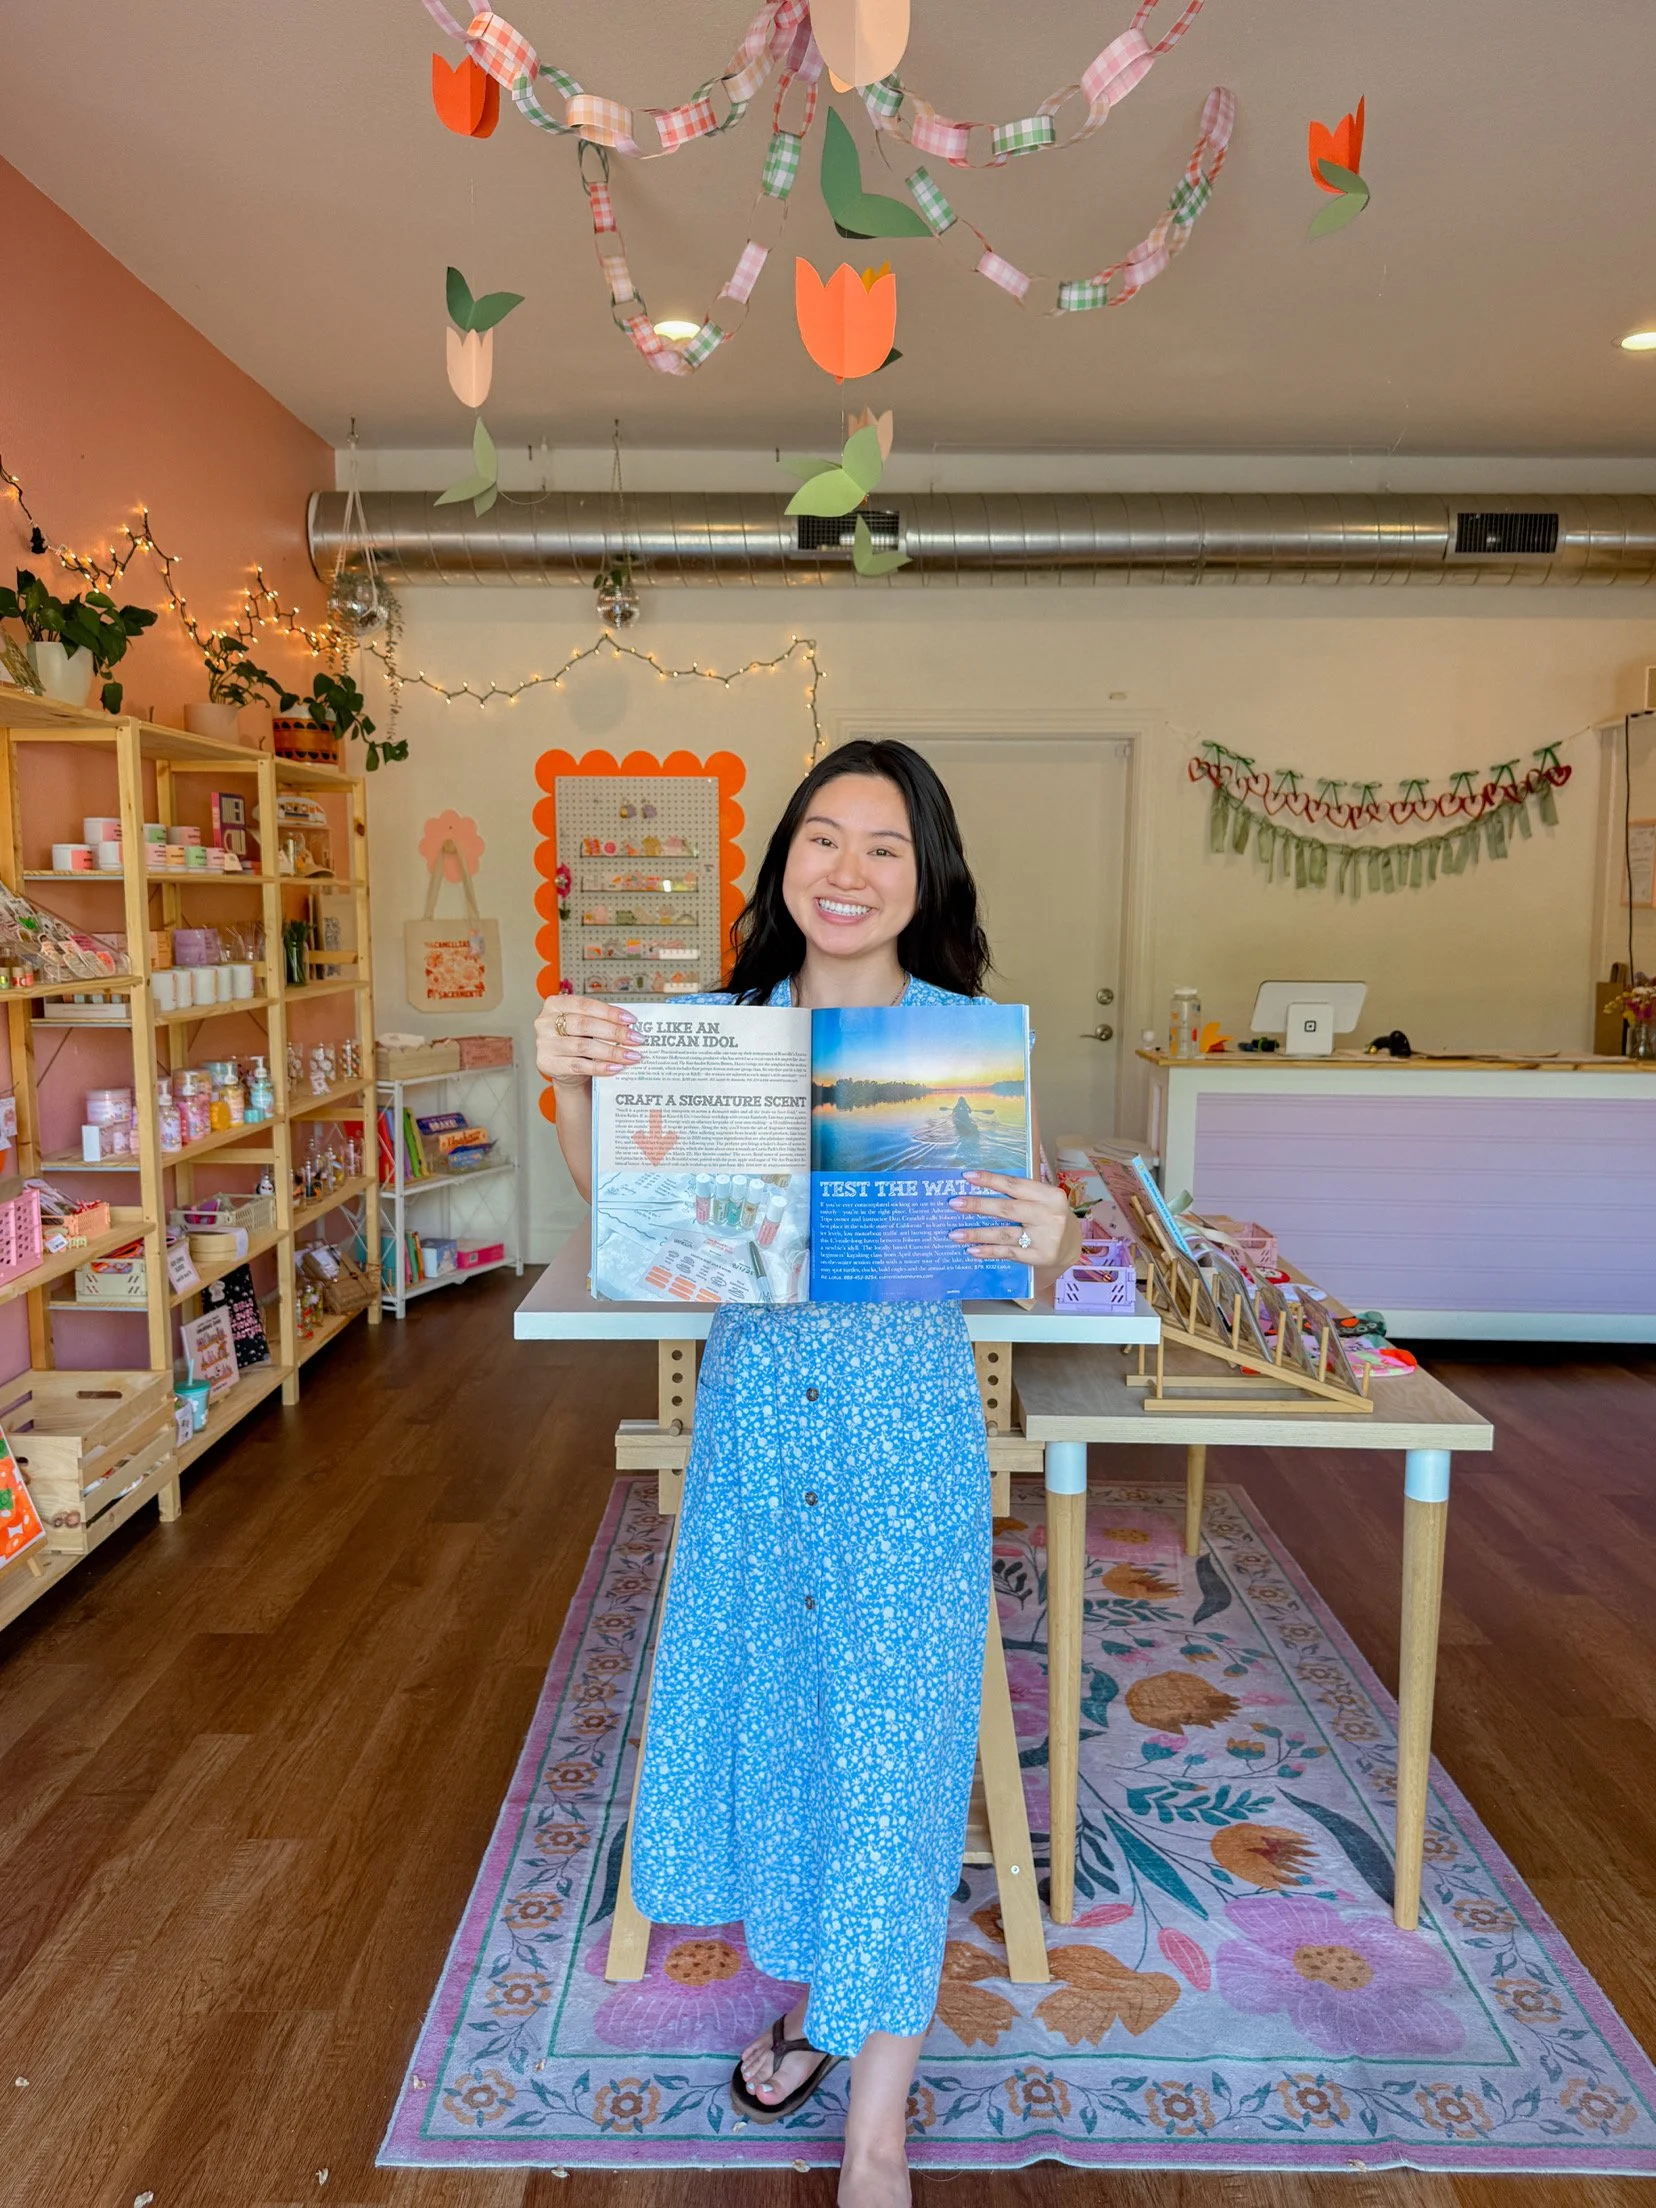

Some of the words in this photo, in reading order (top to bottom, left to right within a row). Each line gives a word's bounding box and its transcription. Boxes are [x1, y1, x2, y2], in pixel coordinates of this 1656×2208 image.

[632, 1022, 653, 1033] NG
[656, 1022, 692, 1034] LIKE
[696, 1022, 720, 1034] AN
[641, 1035, 699, 1047] ERICAN
[702, 1036, 738, 1048] IDOL
[616, 1094, 662, 1106] CRAFT
[666, 1096, 677, 1106] A
[679, 1095, 762, 1107] SIGNATURE
[764, 1096, 807, 1108] SCENT
[820, 1181, 870, 1197] TEST
[875, 1180, 918, 1196] THE
